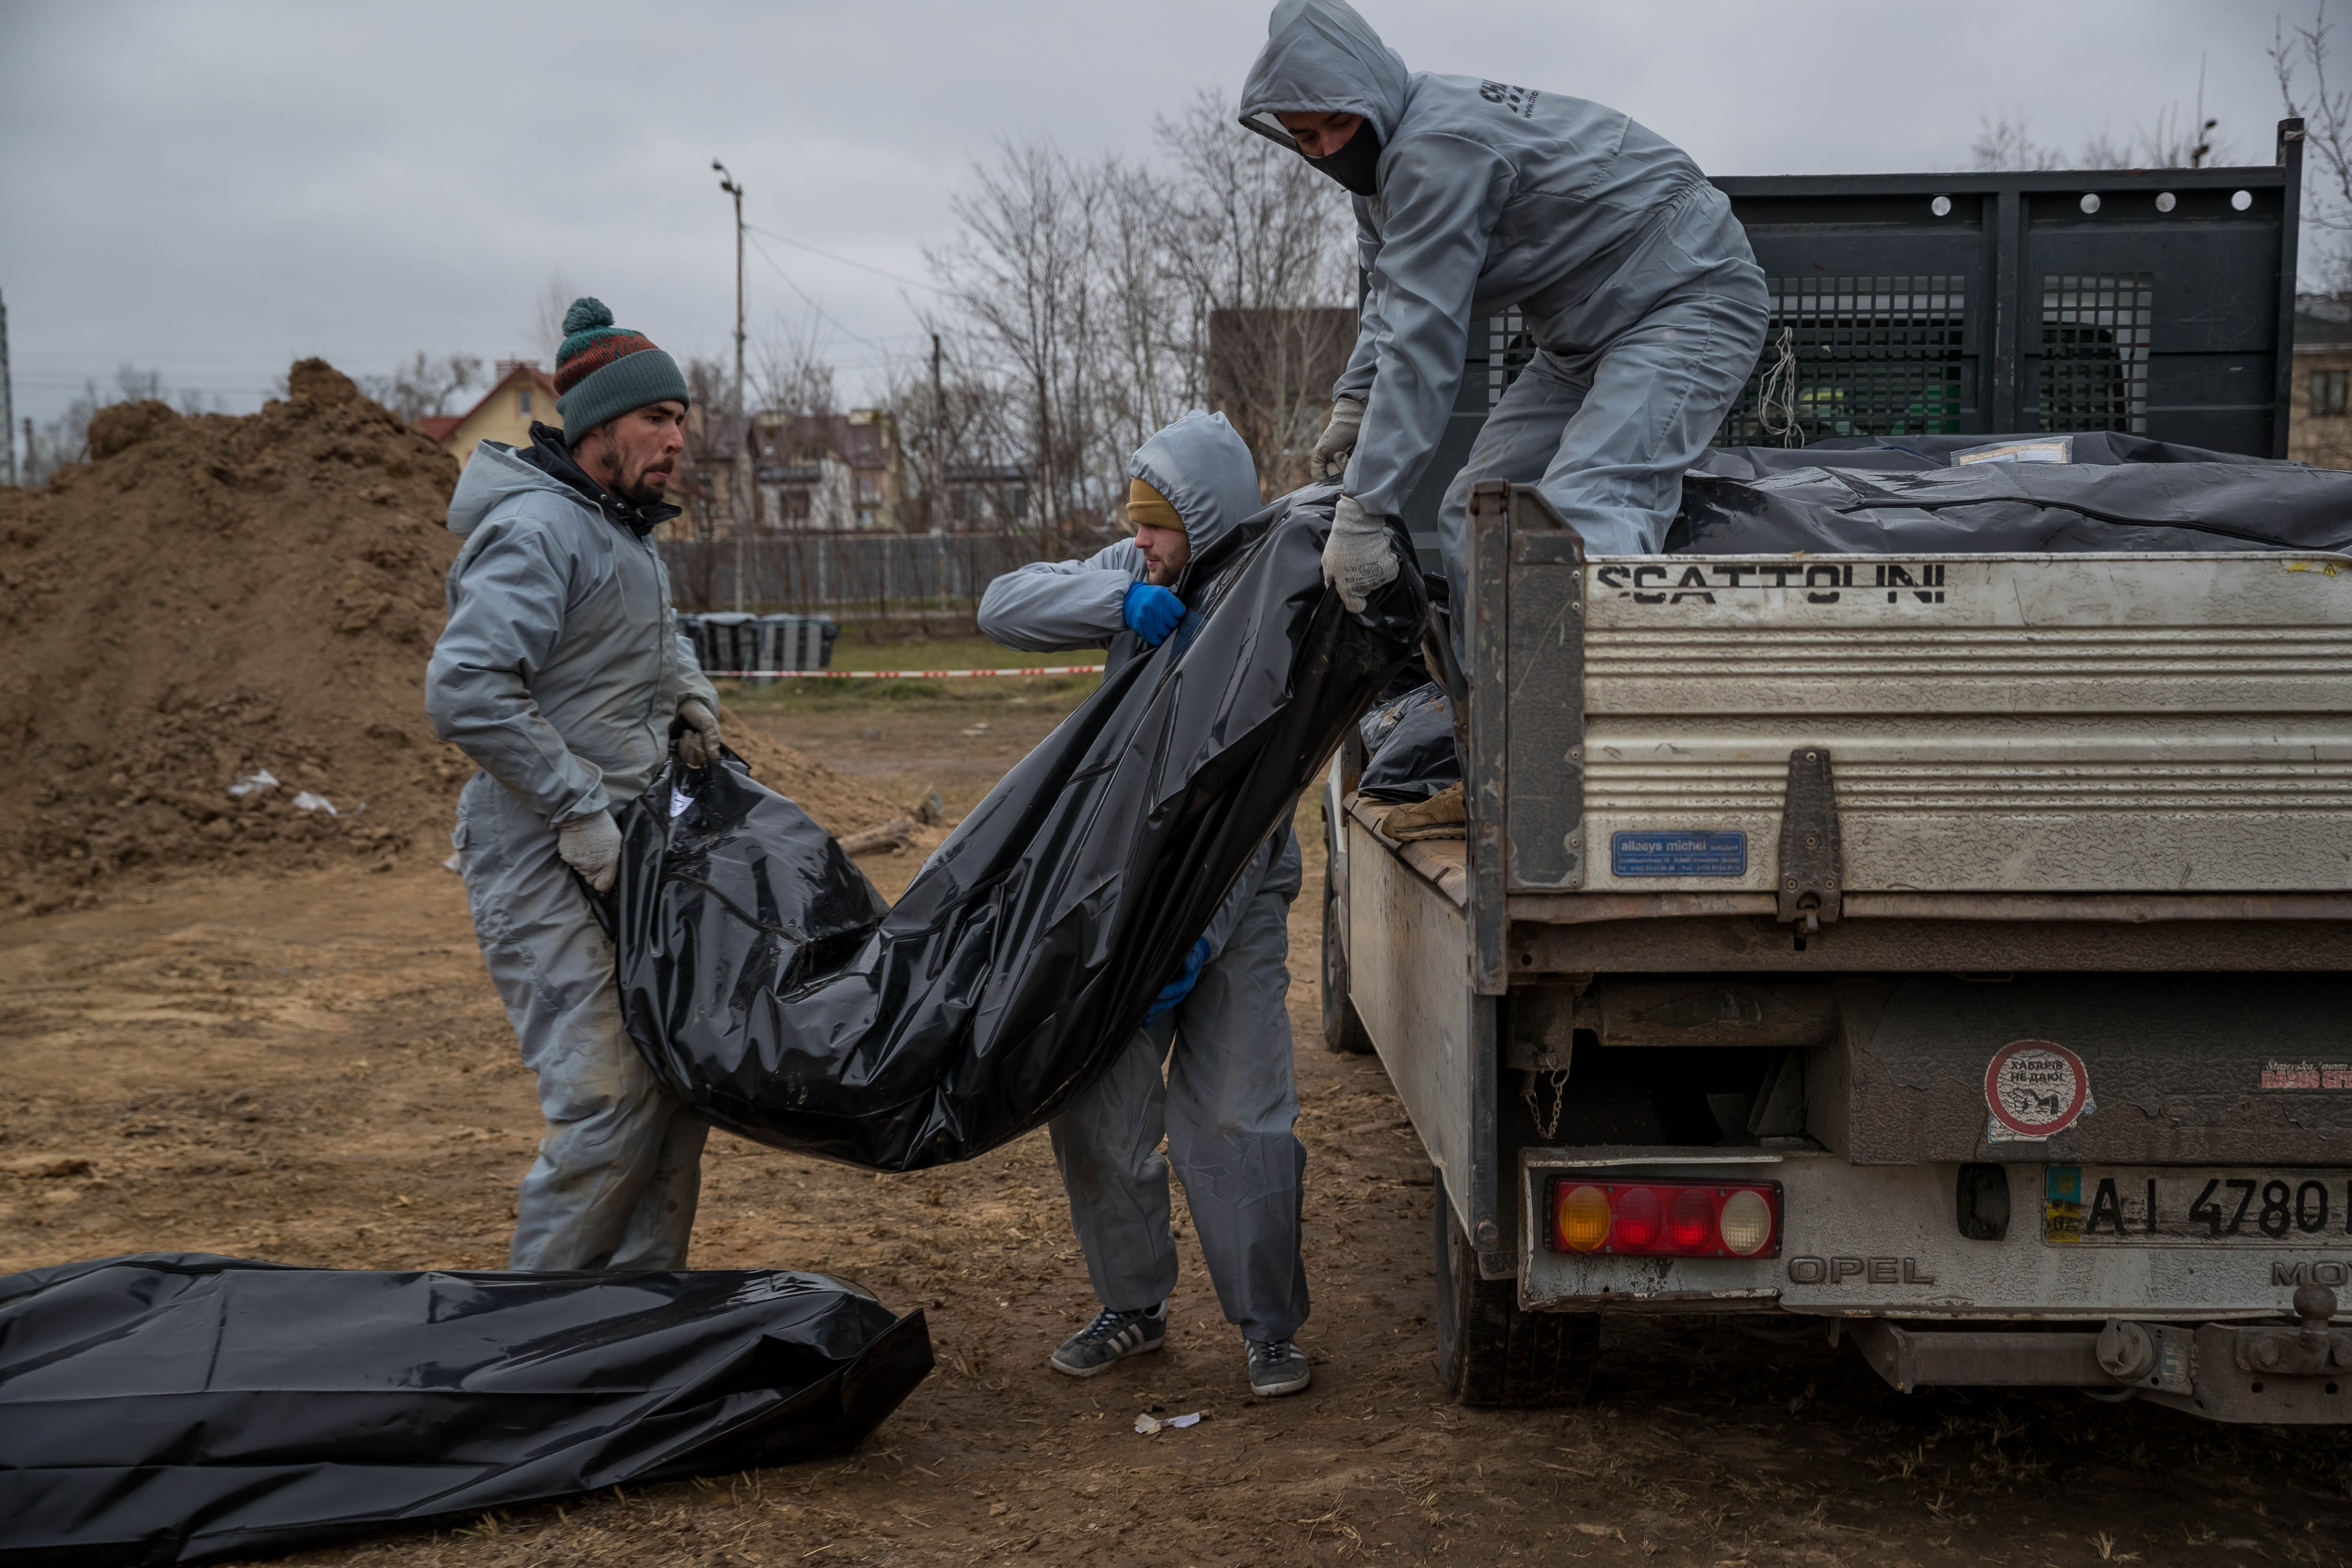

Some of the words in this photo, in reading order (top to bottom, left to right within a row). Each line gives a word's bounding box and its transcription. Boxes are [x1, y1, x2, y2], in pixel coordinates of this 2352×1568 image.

[1666, 840, 1707, 851] michel
[2010, 1061, 2063, 1070] ХАБАРІВ
[2011, 1072, 2026, 1082] НЕ
[2262, 1070, 2320, 1088] RADIO
[2322, 1070, 2352, 1088] CIT
[2086, 1178, 2157, 1235] AI
[2189, 1178, 2328, 1238] 4780
[1788, 1256, 1934, 1284] OPEL
[2272, 1262, 2352, 1287] MO
